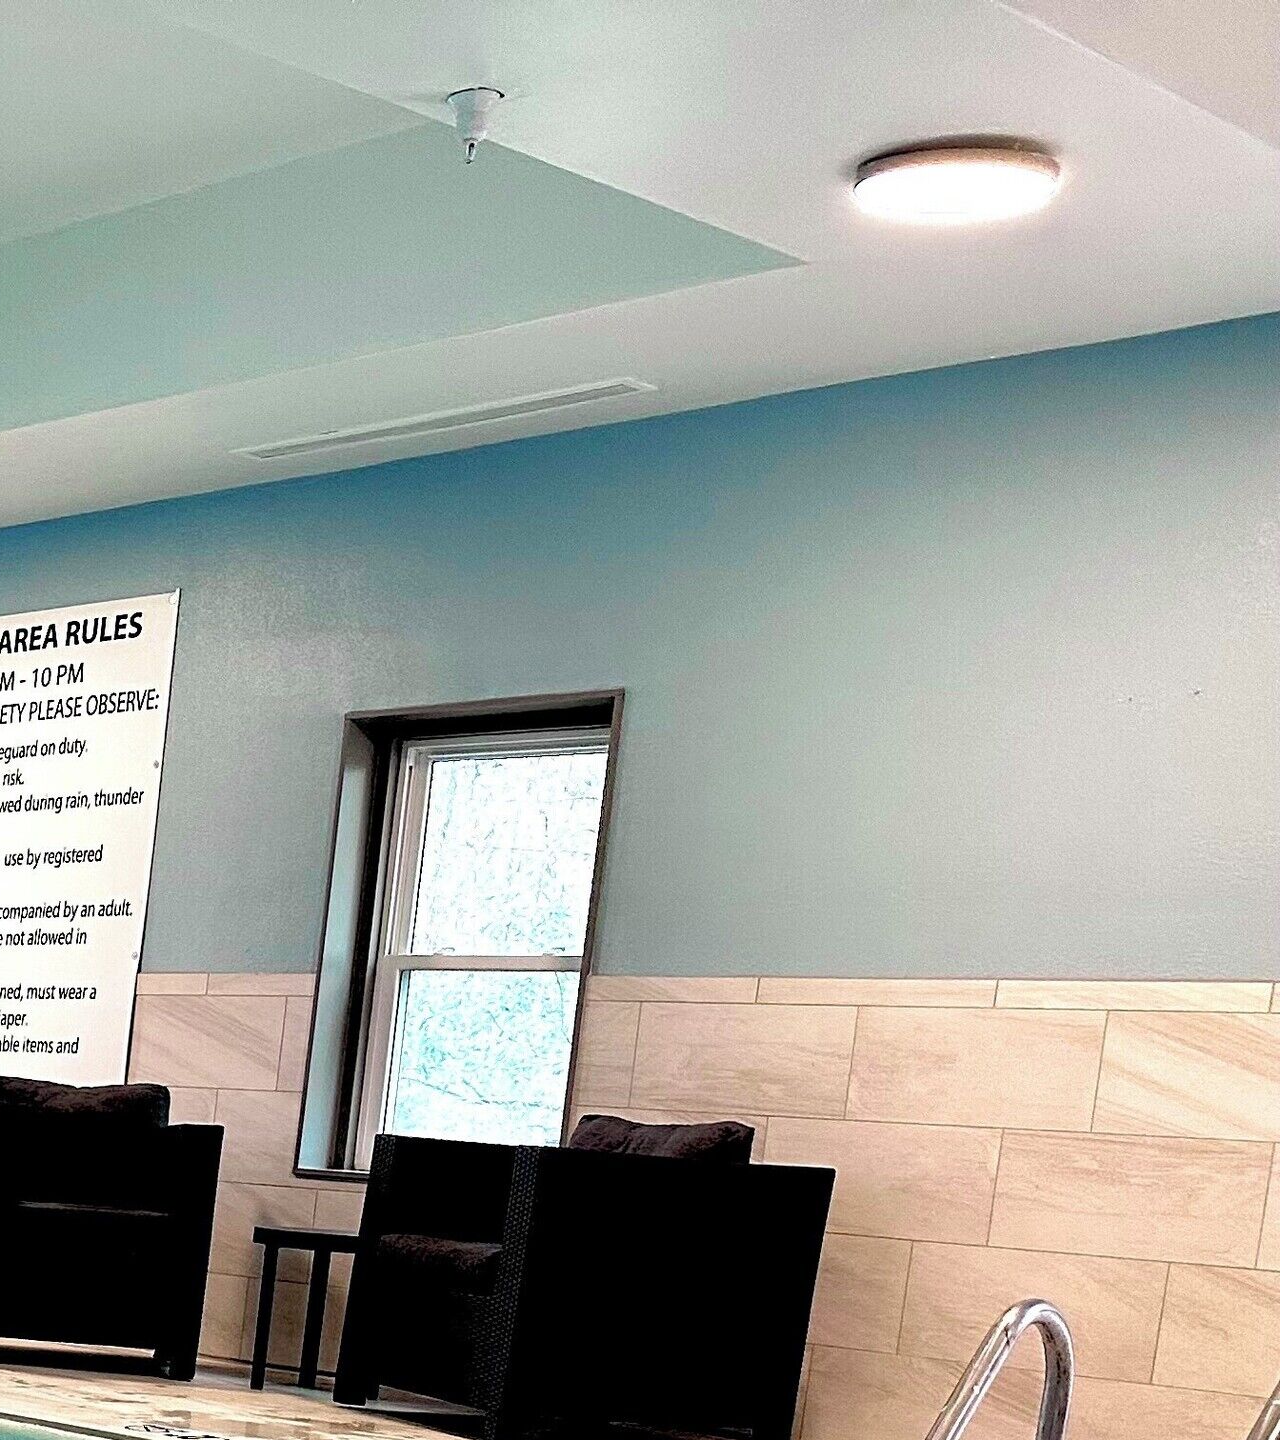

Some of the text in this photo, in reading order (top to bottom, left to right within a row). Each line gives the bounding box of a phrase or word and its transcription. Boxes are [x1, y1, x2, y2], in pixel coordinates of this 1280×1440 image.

[66, 612, 143, 645] RULES
[32, 668, 50, 688] 10
[57, 663, 84, 685] PM
[29, 698, 82, 722] PLEASE
[87, 689, 159, 715] OBSERVE:
[41, 743, 55, 756] on
[59, 738, 88, 757] duty.
[3, 770, 24, 785] risk.
[25, 794, 62, 813] during
[66, 792, 90, 810] rain,
[94, 789, 144, 807] thunder
[5, 852, 23, 866] use
[27, 850, 41, 868] by
[44, 845, 103, 867] registered
[63, 900, 78, 921] by
[81, 904, 95, 917] an
[98, 899, 132, 917] adult.
[6, 932, 24, 945] not
[28, 928, 73, 945] allowed
[76, 929, 86, 944] in
[27, 985, 55, 999] must
[58, 987, 88, 999] wear
[89, 988, 96, 999] a
[23, 1038, 53, 1053] items
[56, 1038, 78, 1054] and
